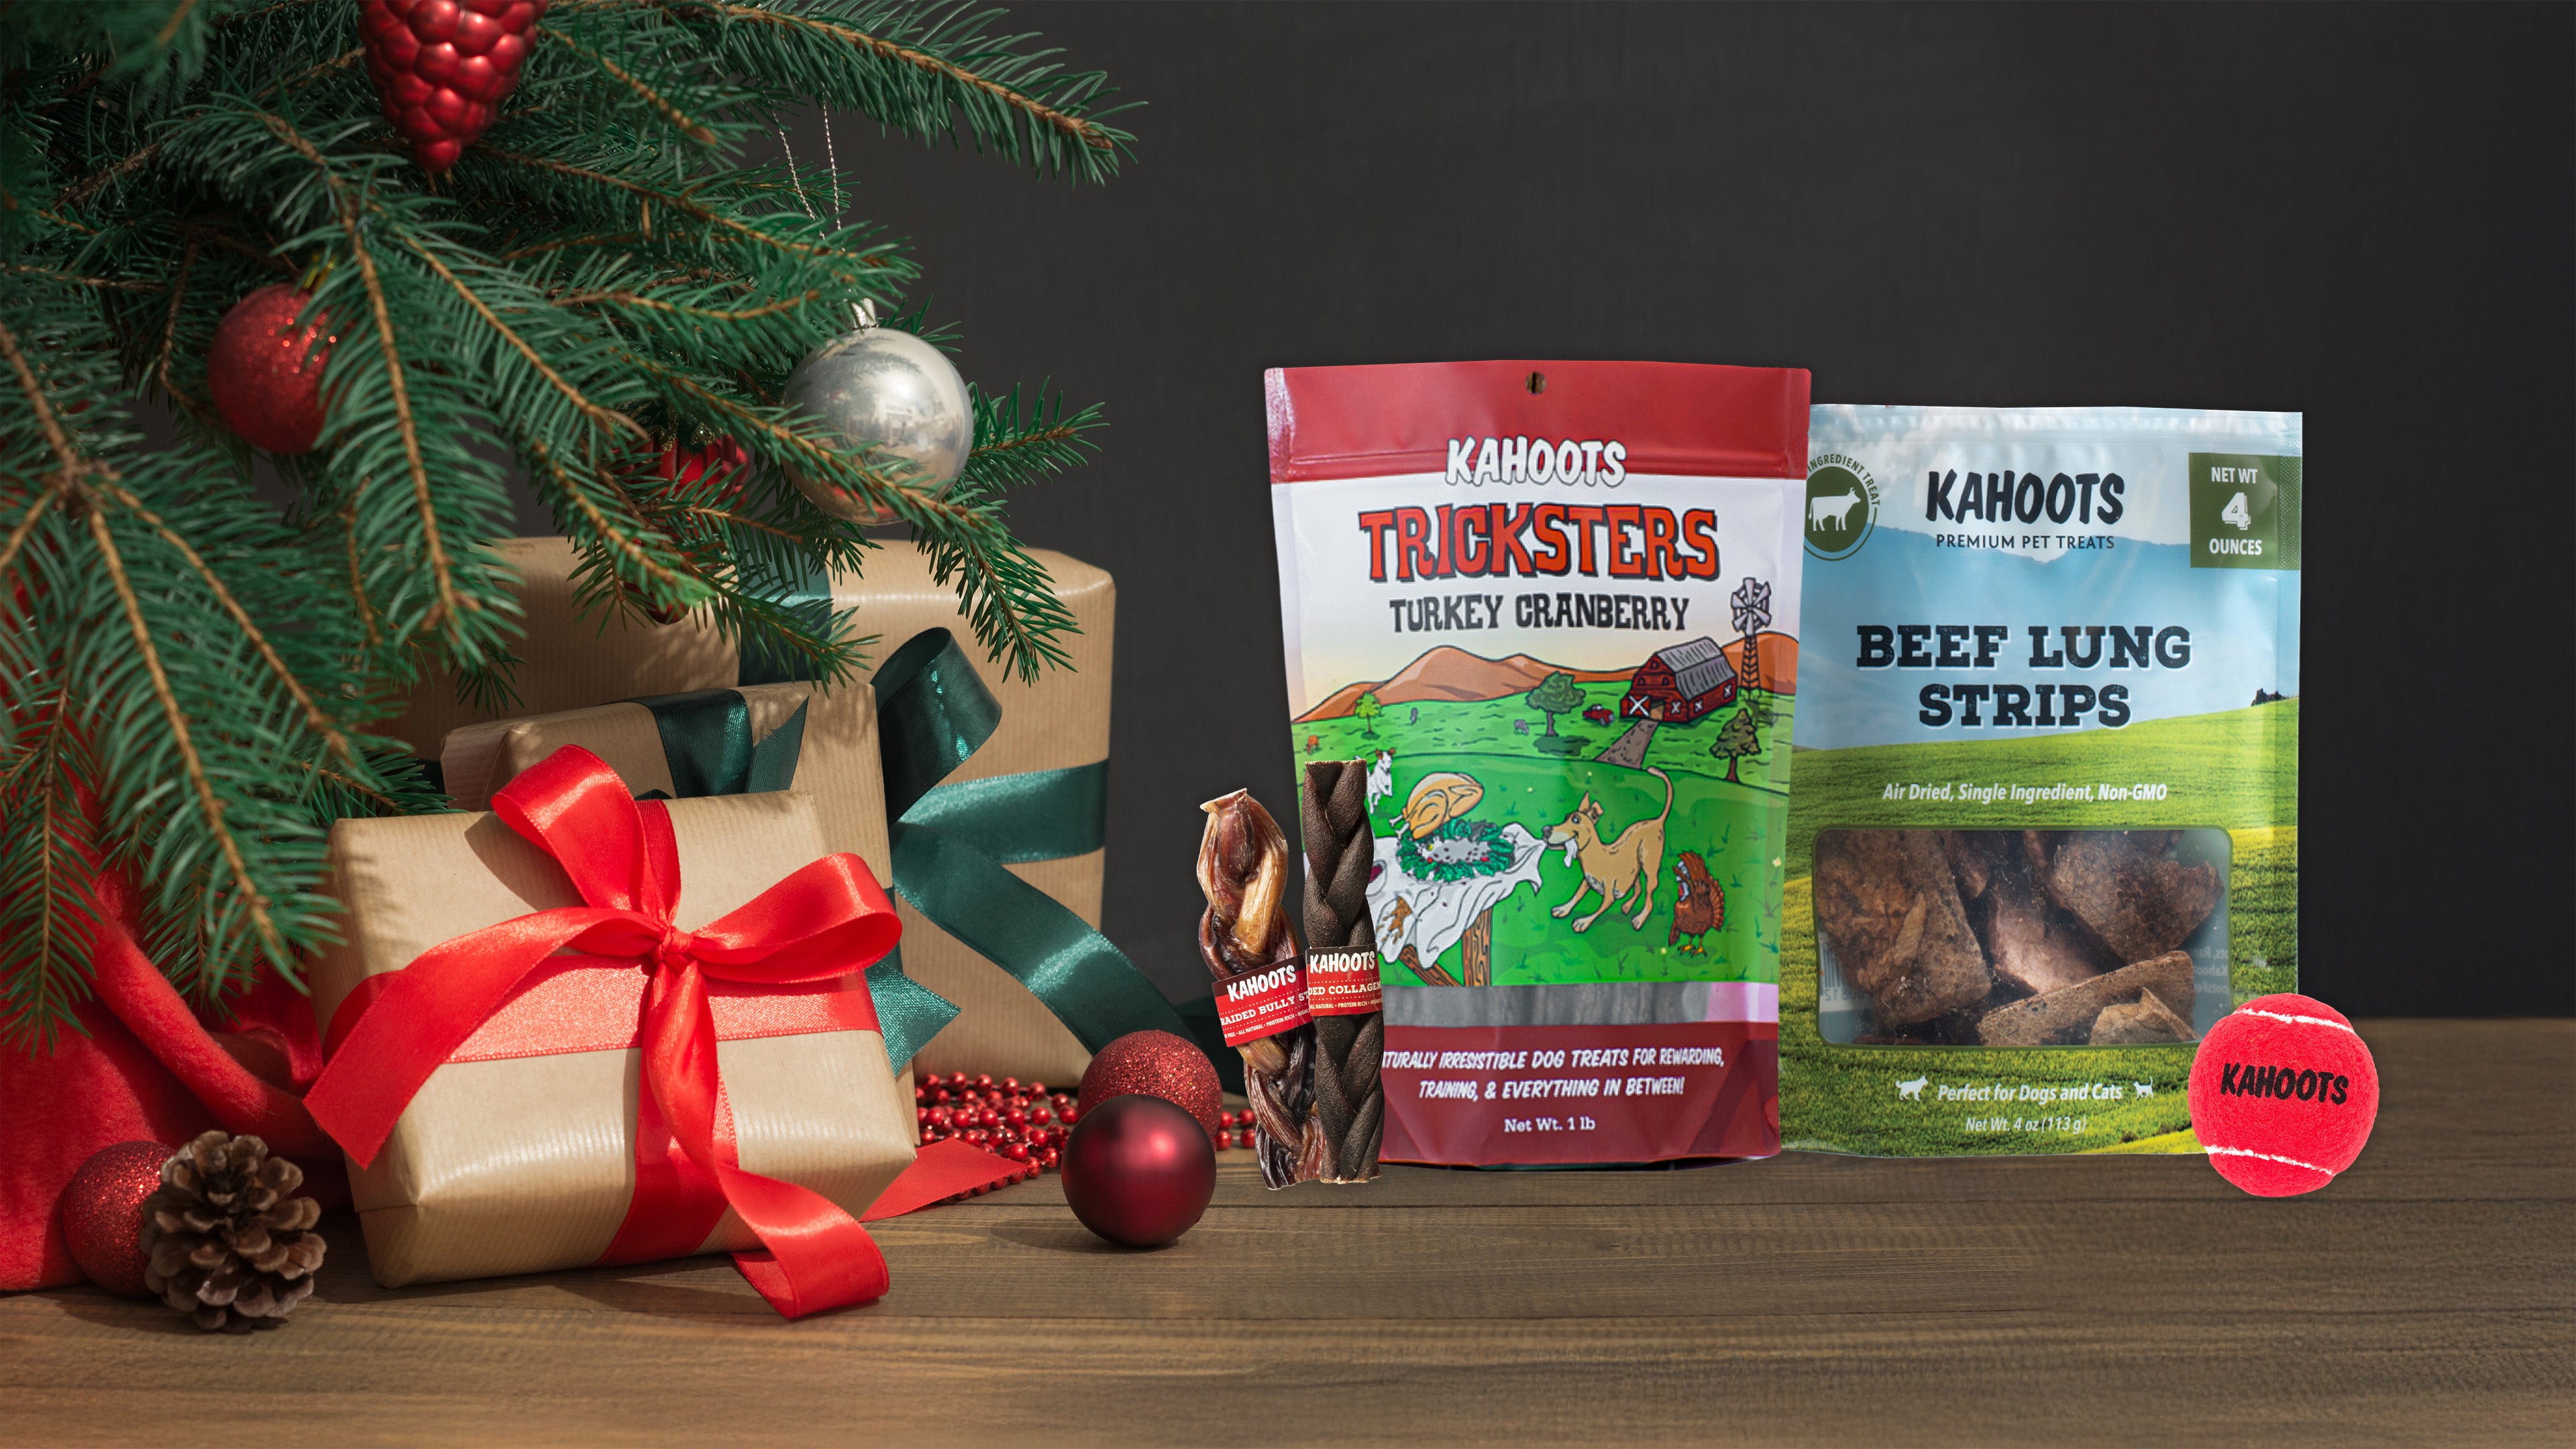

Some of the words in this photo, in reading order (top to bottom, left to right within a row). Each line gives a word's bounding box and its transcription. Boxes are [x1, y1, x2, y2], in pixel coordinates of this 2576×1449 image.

[1444, 435, 1628, 487] KAHOOTS
[1807, 453, 1864, 474] INGREDIENT
[1862, 472, 1880, 506] TREAT
[2211, 467, 2235, 483] NET
[2238, 468, 2258, 484] WT
[1925, 468, 2125, 525] KAHOOTS
[2222, 492, 2251, 531] 4
[1358, 502, 1720, 582] TRICKSTERS
[1936, 534, 2015, 549] PREMIUM
[2023, 536, 2050, 549] PET
[2058, 536, 2115, 549] TREATS
[2209, 538, 2263, 555] OUNCES
[1389, 594, 1504, 633] TURKEY
[1515, 593, 1690, 631] CRANBERRY
[1856, 625, 2009, 671] BEEF
[2028, 625, 2193, 671] LUNG
[1919, 684, 2132, 730] STRIPS
[1882, 784, 1905, 800] Air
[1909, 783, 1955, 802] Dried,
[1958, 783, 2006, 805] Single
[2010, 784, 2094, 805] Ingredient,
[2098, 784, 2167, 800] Non-GMO
[1309, 950, 1375, 974] KAHOOTS
[1227, 965, 1297, 1002] KAHOOTS
[1308, 986, 1326, 996] DED
[1328, 981, 1382, 995] COLLAGEN
[1220, 1009, 1256, 1026] RAIDED
[1258, 996, 1295, 1015] BULLY
[1298, 990, 1309, 1002] ST
[1245, 1024, 1264, 1034] NATURAL
[1266, 1018, 1284, 1027] PROTEIN
[1438, 1051, 1529, 1070] IRRESISTIBLE
[1532, 1049, 1566, 1069] DOG
[1571, 1048, 1629, 1068] TREATS
[1632, 1047, 1657, 1067] FOR
[1659, 1046, 1725, 1068] REWARDING,
[1418, 1080, 1479, 1102] TRAINING,
[1484, 1081, 1497, 1100] &
[1501, 1078, 1600, 1099] EVERYTHING
[1603, 1078, 1621, 1097] IN
[1625, 1075, 1686, 1097] BETWEEN!
[1938, 1083, 1990, 1102] Perfect
[1994, 1083, 2017, 1102] for
[2019, 1084, 2056, 1106] Dogs
[2059, 1083, 2088, 1101] and
[2092, 1083, 2123, 1100] Cats
[2220, 1062, 2349, 1105] KAHOOTS
[1504, 1118, 1532, 1132] Net
[1536, 1117, 1563, 1132] Wt.
[1567, 1116, 1575, 1131] 1
[1579, 1116, 1597, 1131] lb
[1966, 1117, 1987, 1132] Net
[1990, 1117, 2010, 1131] Wt.
[2013, 1117, 2022, 1131] 4
[2025, 1121, 2039, 1131] oz
[2041, 1116, 2070, 1133] (113
[2073, 1116, 2087, 1135] g)
